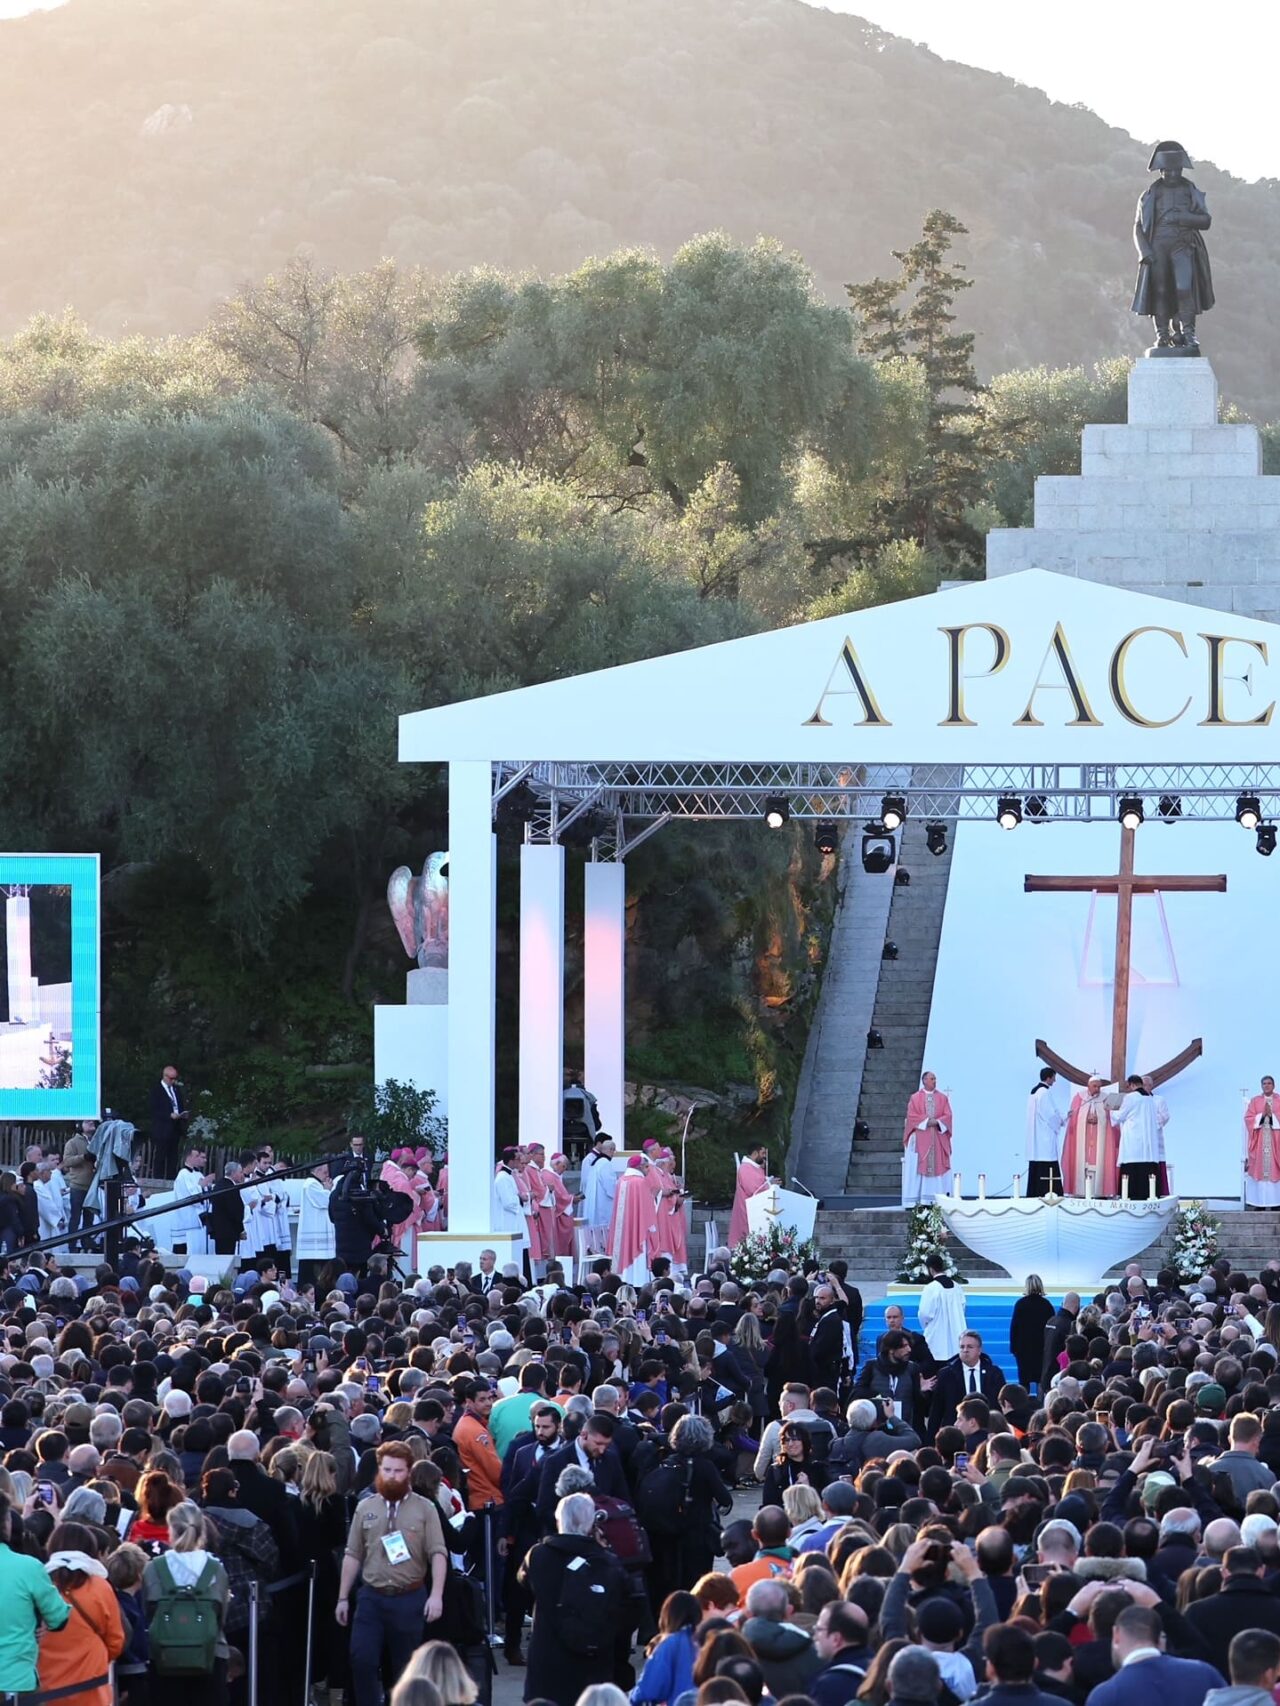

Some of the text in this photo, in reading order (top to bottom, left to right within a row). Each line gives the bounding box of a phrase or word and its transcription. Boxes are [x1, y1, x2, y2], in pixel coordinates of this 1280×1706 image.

[801, 621, 1276, 729] A PACE
[1110, 1202, 1136, 1210] MARIS
